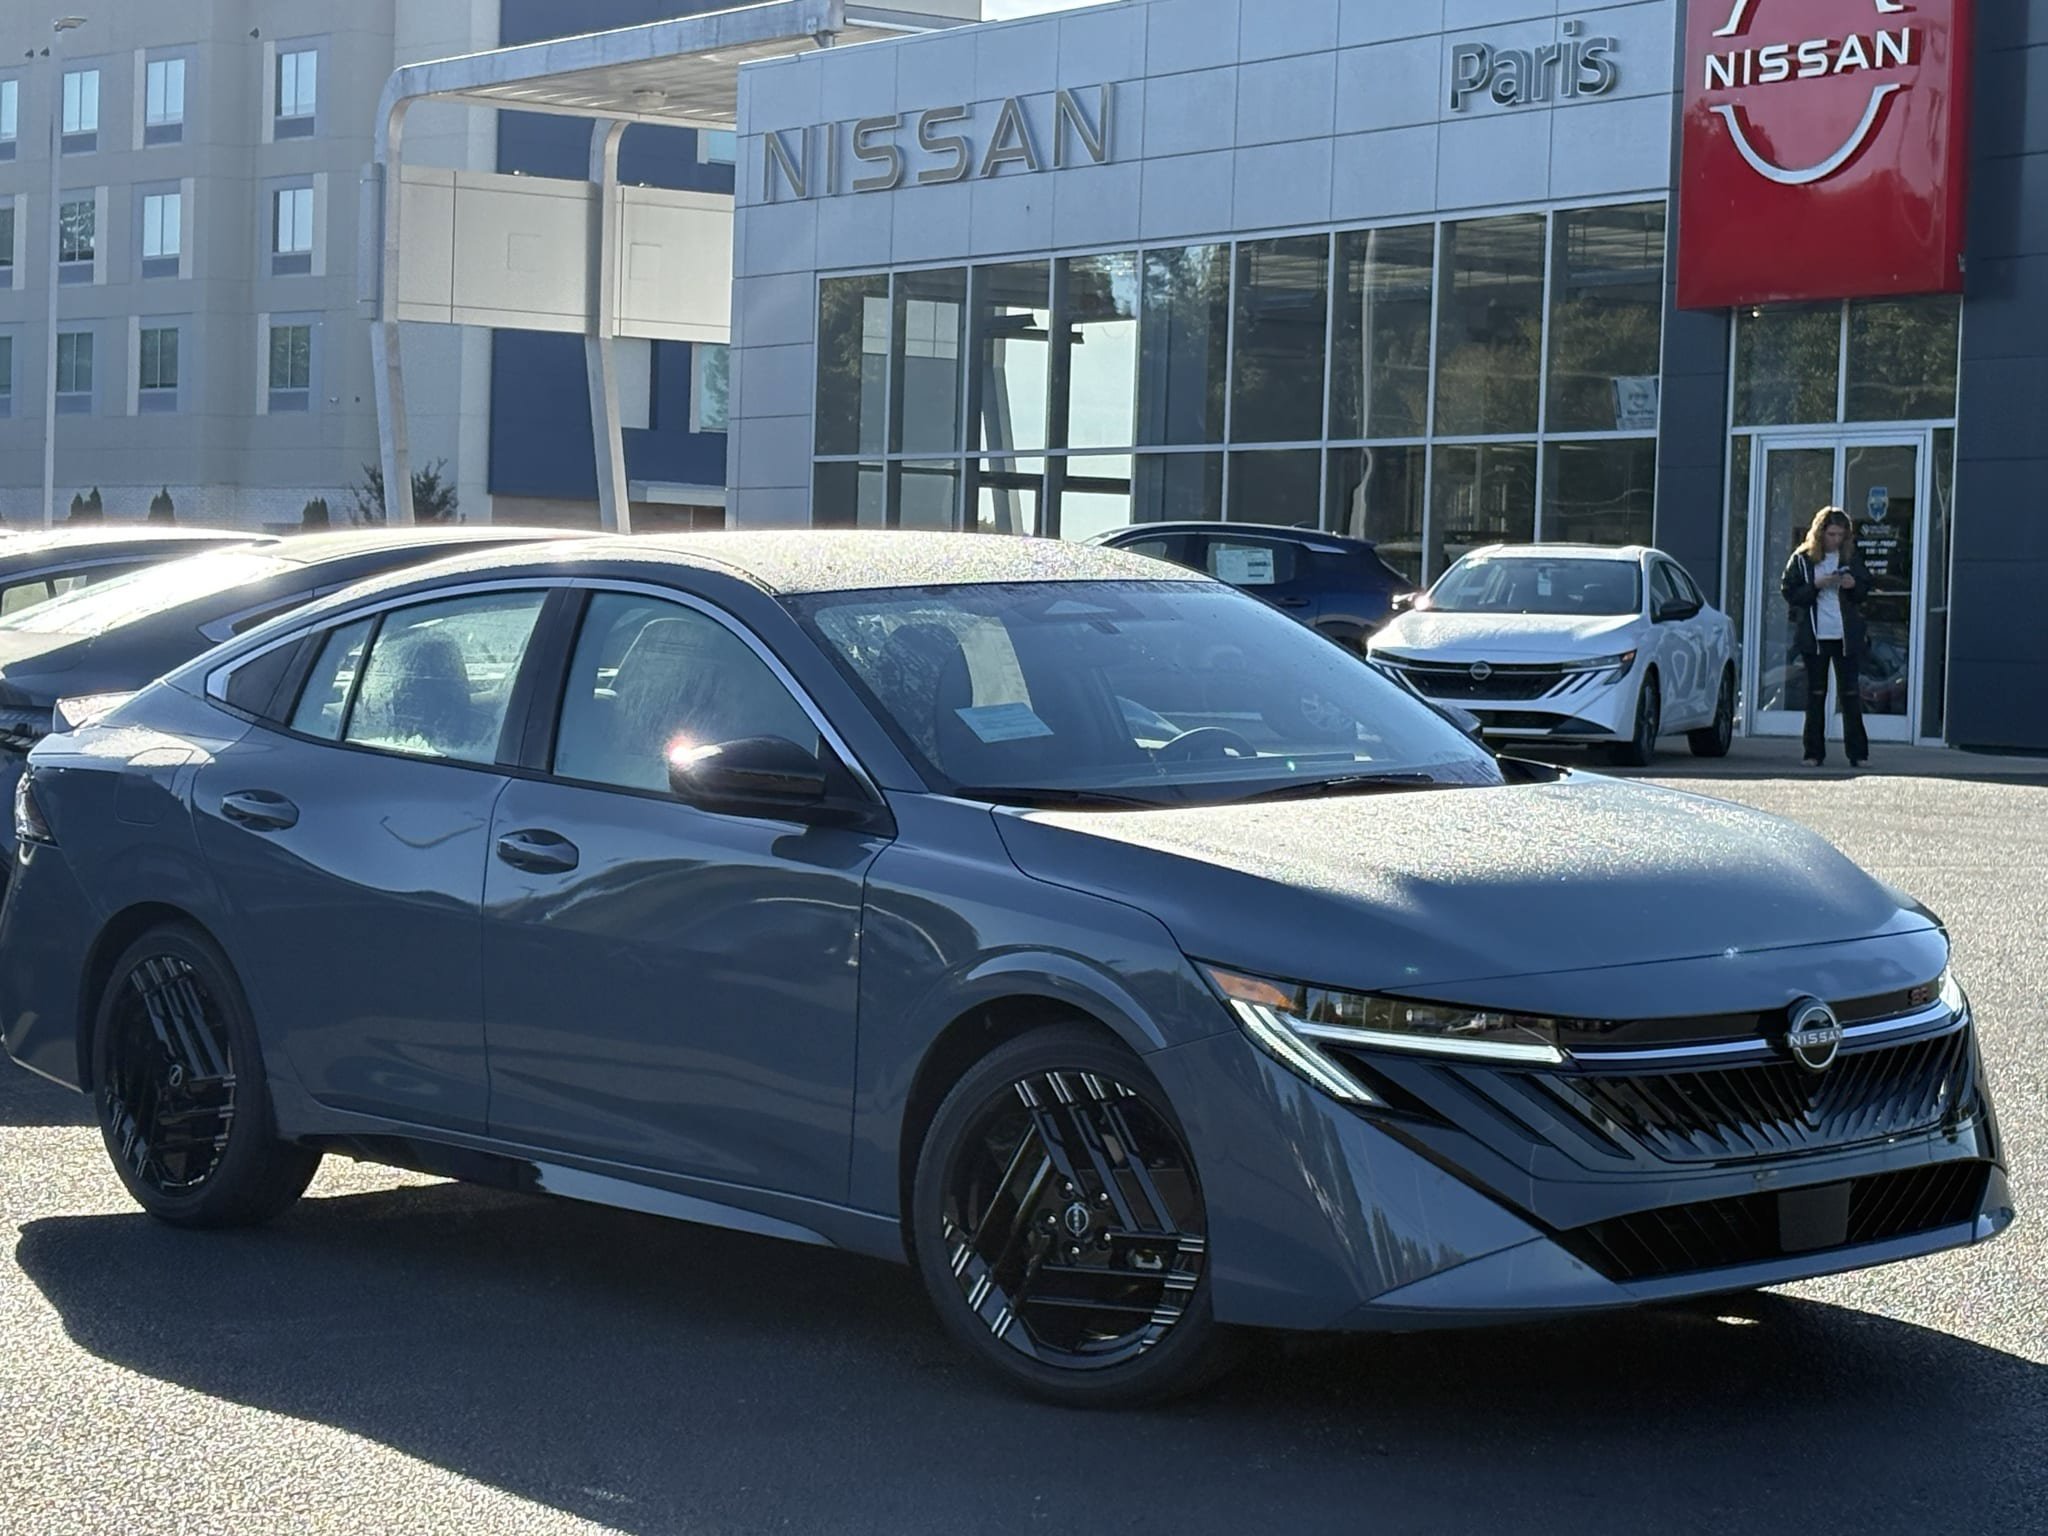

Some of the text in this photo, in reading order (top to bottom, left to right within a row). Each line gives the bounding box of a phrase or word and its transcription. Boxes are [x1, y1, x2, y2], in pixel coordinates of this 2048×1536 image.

[1449, 20, 1619, 112] Paris
[1705, 27, 1910, 90] NISSAN
[763, 82, 1115, 205] NISSAN
[1790, 1030, 1841, 1047] NISSAN
